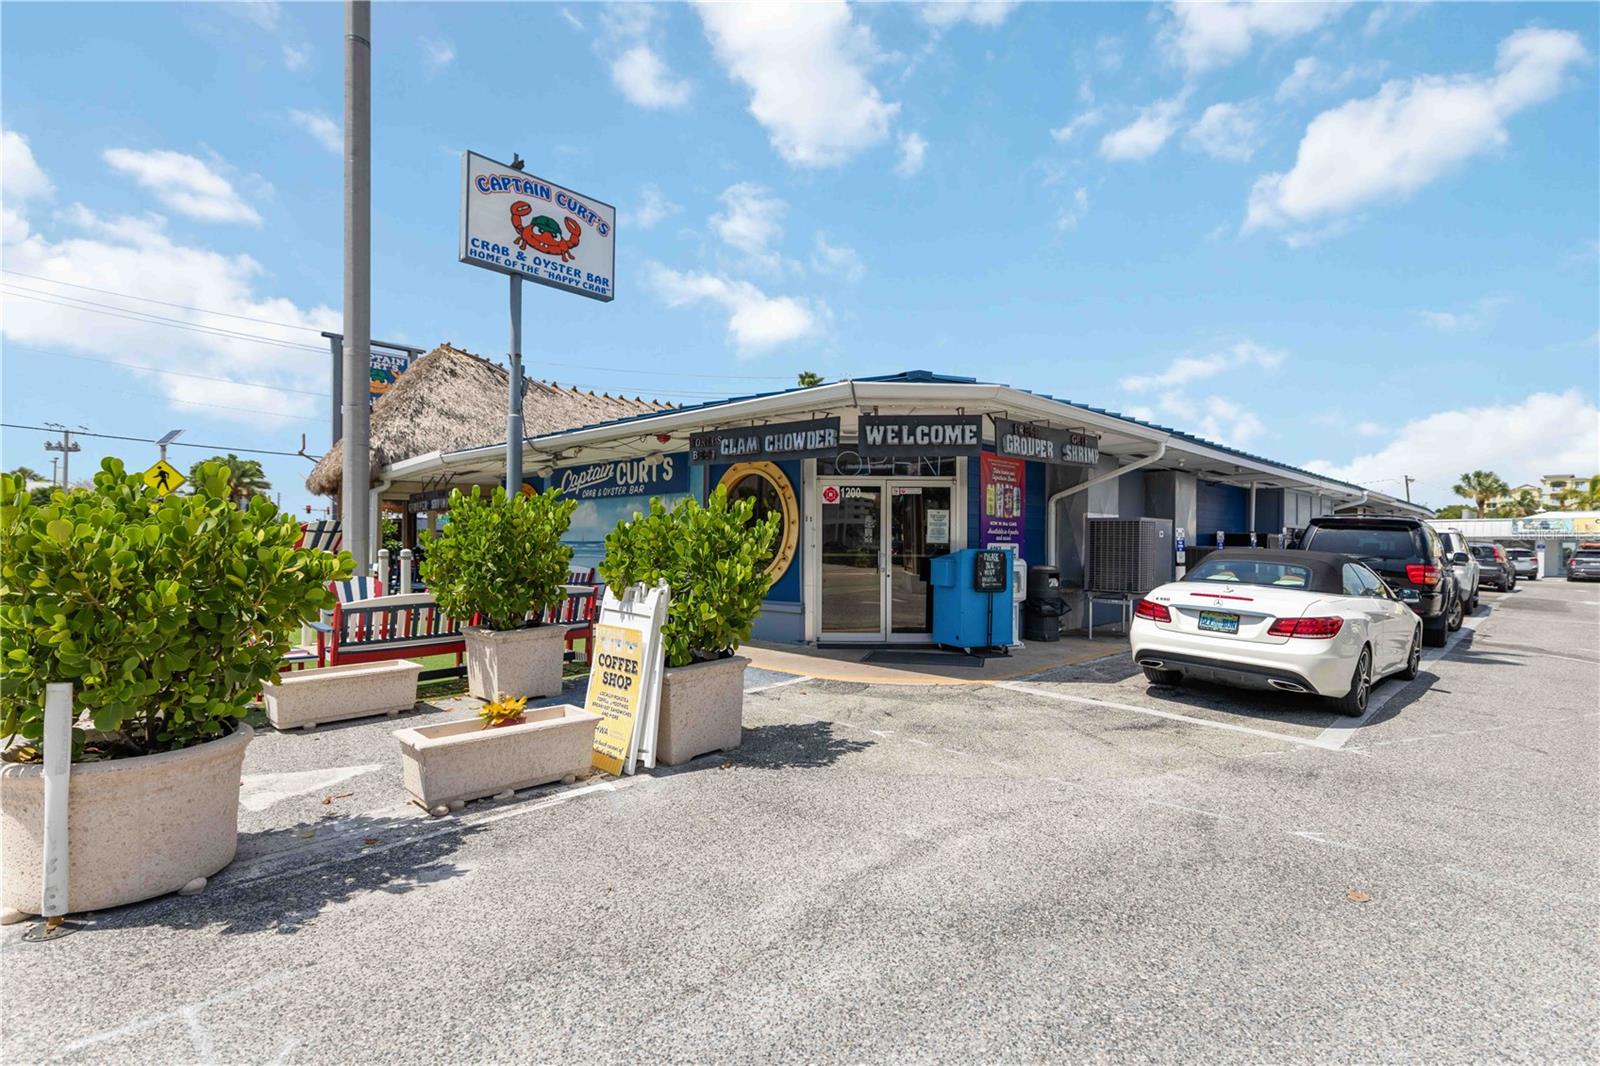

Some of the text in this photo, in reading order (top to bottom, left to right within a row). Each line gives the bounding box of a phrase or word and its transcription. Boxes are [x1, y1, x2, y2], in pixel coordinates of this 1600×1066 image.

[476, 175, 610, 237] CAPTAIN CURT'S
[470, 249, 501, 264] HOME
[504, 259, 517, 267] OF
[520, 264, 539, 274] THE
[471, 238, 609, 287] CRAB & OYSTER BAR
[370, 354, 405, 367] TAIN
[721, 437, 759, 455] CLAM
[765, 428, 838, 452] CHOWDER
[865, 425, 977, 445] WELCOME
[1003, 434, 1100, 464] GROUPER SHRIMP
[561, 457, 673, 494] Captain CURTS
[582, 489, 596, 498] CRAB
[603, 486, 626, 496] OYSTER
[629, 485, 645, 494] BAR
[840, 487, 861, 498] 1200
[598, 653, 639, 674] COFFEE
[602, 673, 632, 691] SHOP
